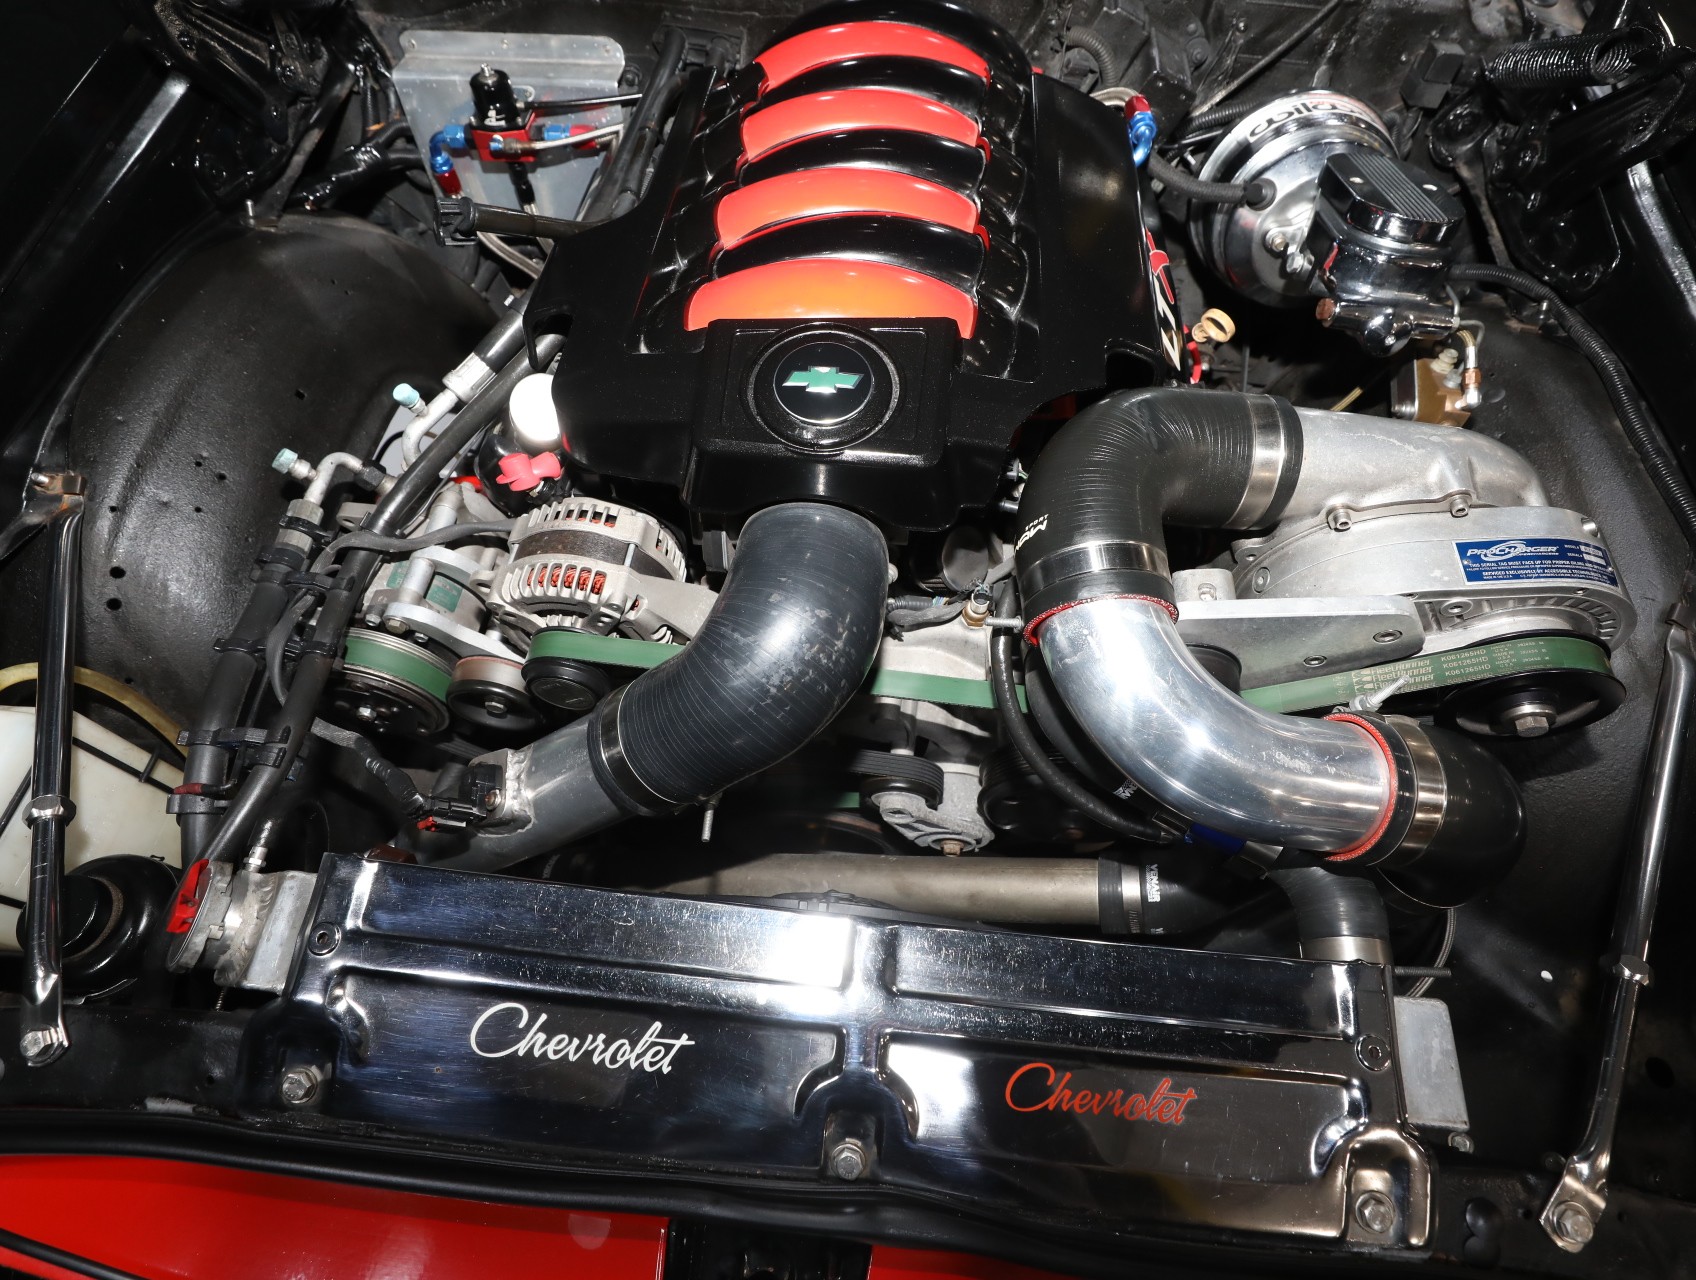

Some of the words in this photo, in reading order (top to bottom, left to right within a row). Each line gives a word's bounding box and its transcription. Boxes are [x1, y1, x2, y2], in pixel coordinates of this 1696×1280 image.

[1441, 648, 1487, 662] K061265HD
[1443, 656, 1489, 669] K061265HD
[1445, 663, 1491, 677] K061265HD
[470, 1002, 695, 1075] Chevrolet
[1005, 1062, 1198, 1125] Chevrolet
